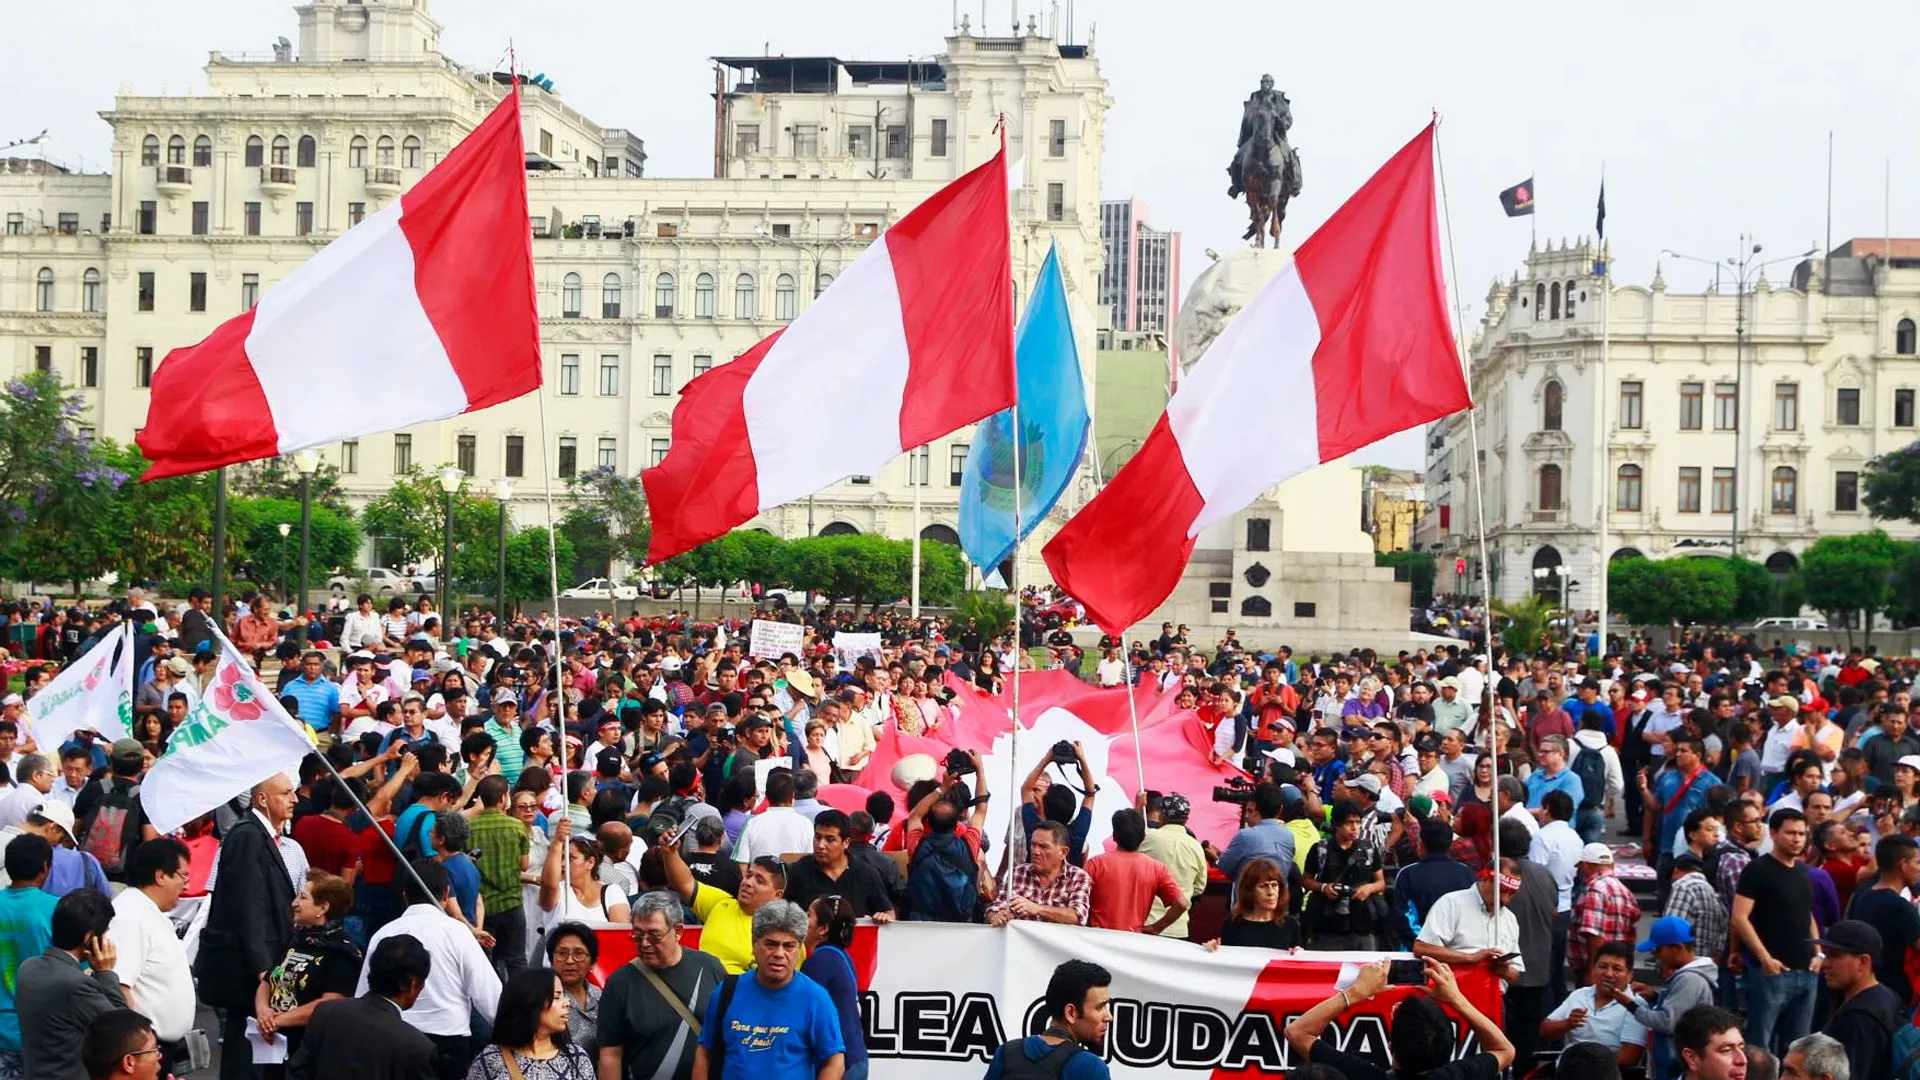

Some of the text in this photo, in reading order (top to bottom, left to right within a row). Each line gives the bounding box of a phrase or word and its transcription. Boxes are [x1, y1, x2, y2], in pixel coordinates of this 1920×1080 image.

[731, 1020, 751, 1032] Para
[752, 1025, 769, 1035] que
[858, 991, 1008, 1064] LEA
[741, 1035, 752, 1045] el
